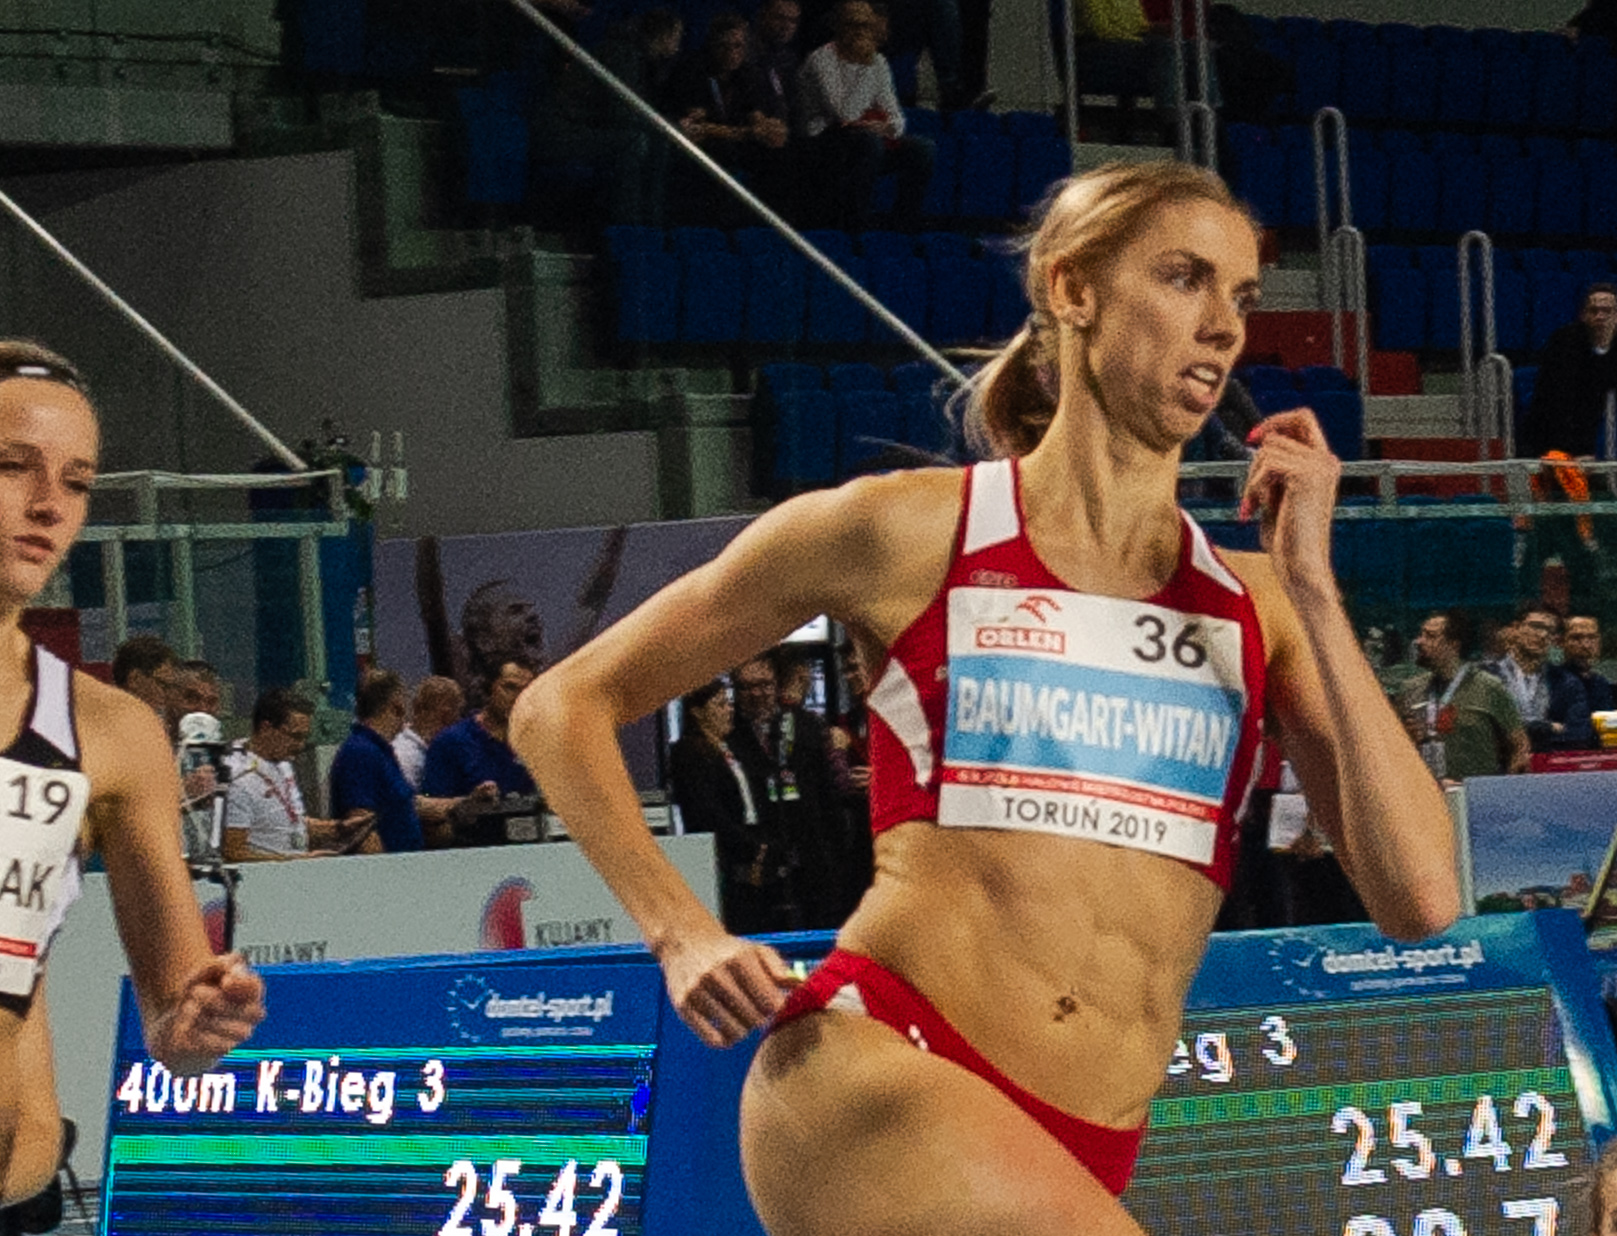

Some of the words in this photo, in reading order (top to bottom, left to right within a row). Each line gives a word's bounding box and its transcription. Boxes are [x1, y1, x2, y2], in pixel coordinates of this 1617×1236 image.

[977, 629, 1063, 653] ORLEN
[1132, 614, 1208, 670] 36
[957, 676, 1231, 769] BAUMGART-WITAN
[1003, 797, 1100, 831] TORUŃ
[1109, 811, 1167, 845] 2019
[1259, 1015, 1298, 1066] 3
[255, 1054, 396, 1125] K-Bieg
[417, 1058, 445, 1112] 3
[1330, 1091, 1570, 1186] 25.42
